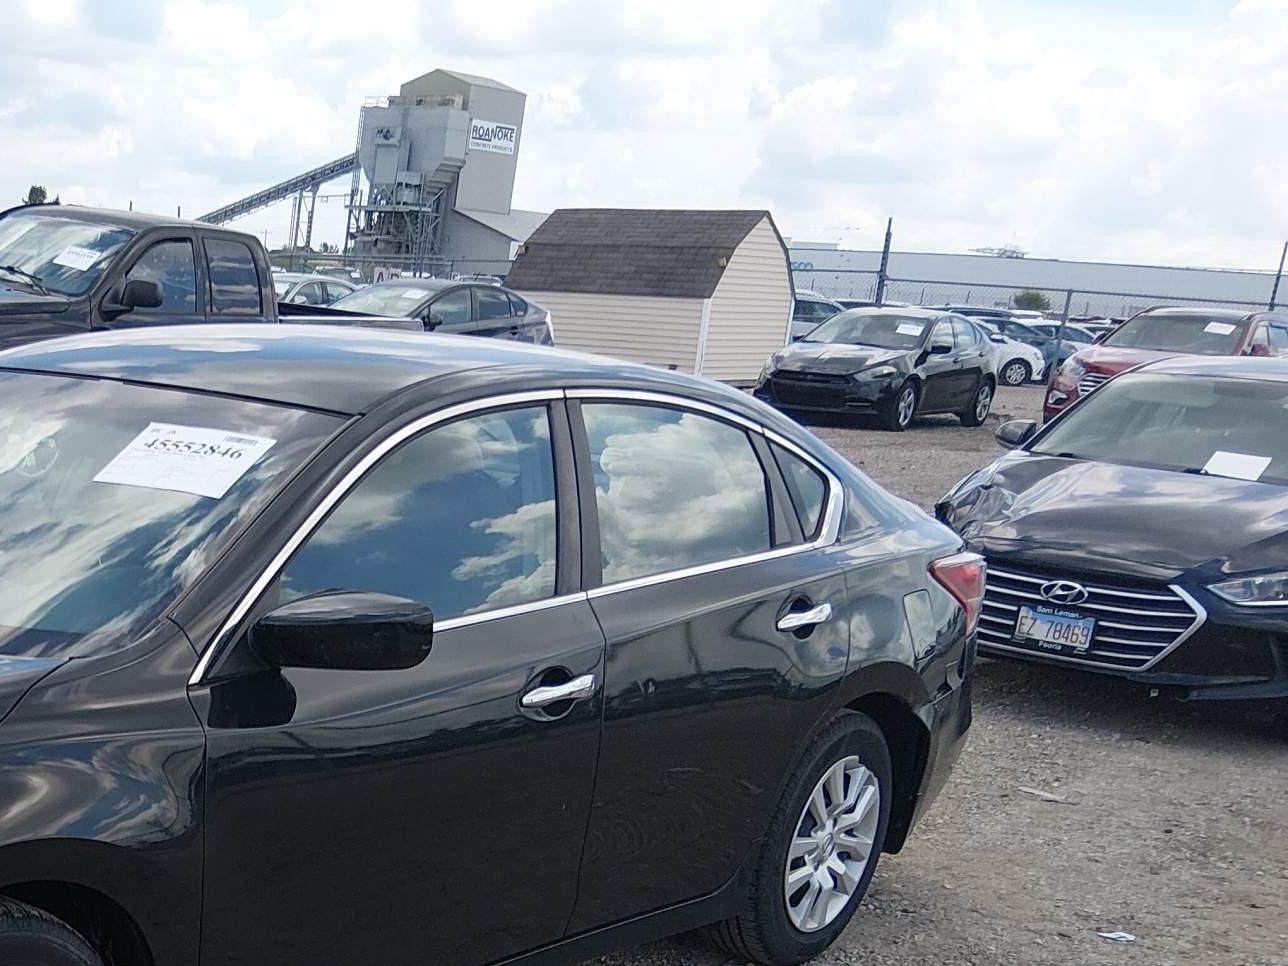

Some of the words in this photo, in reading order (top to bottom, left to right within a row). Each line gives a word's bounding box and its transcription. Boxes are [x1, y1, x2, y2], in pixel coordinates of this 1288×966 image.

[472, 124, 515, 143] ROANOKE
[144, 438, 243, 460] 45552846
[1018, 616, 1037, 635] EZ
[1045, 620, 1090, 645] 78469
[1038, 640, 1062, 651] Peoria
